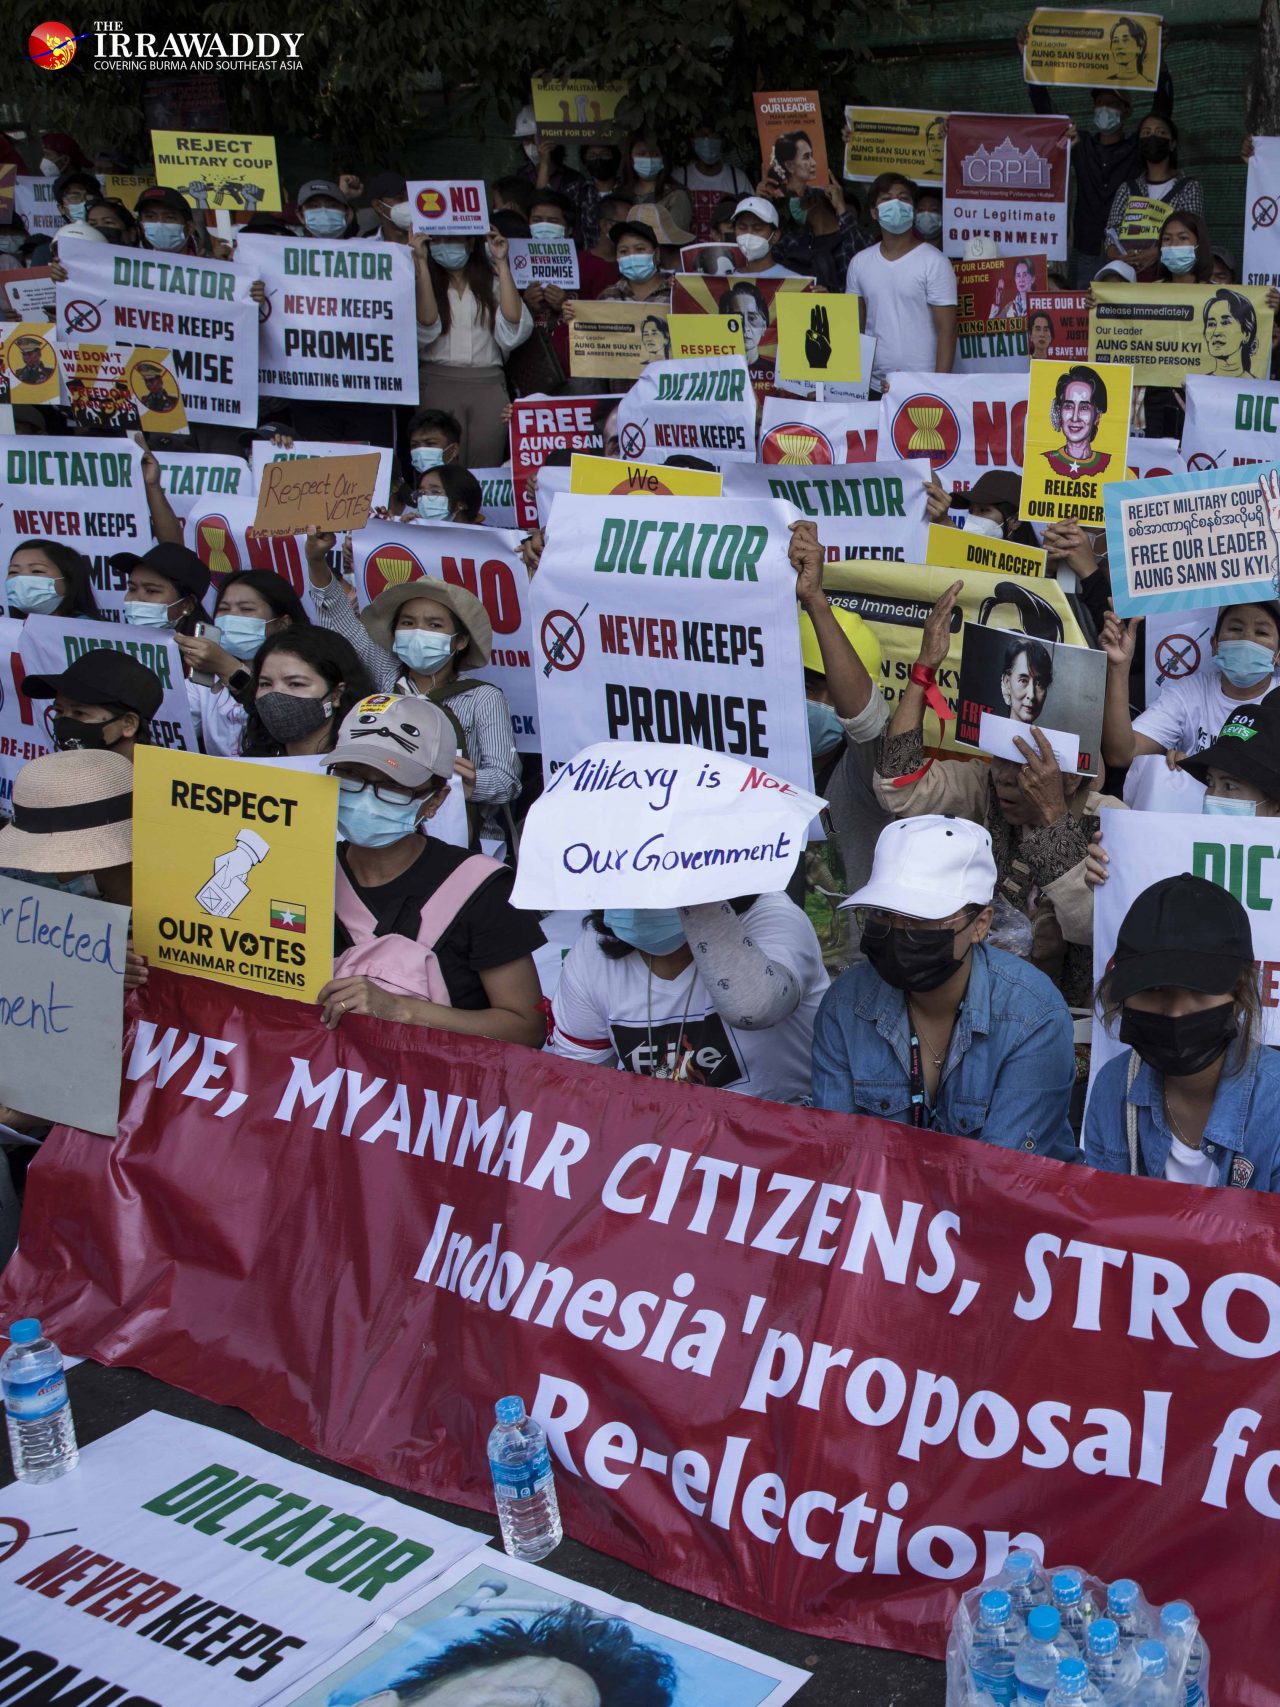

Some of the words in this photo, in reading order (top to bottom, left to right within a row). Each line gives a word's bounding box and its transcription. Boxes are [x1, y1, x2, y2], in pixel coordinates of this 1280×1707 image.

[177, 138, 252, 154] REJECT
[159, 154, 227, 168] MILITARY
[233, 157, 273, 169] COUP
[968, 157, 1044, 185] CRPH
[449, 187, 480, 213] NO
[954, 207, 977, 219] Our
[984, 207, 1056, 223] Legitimate
[528, 243, 571, 255] DICTATOR
[530, 256, 551, 264] NEVER
[552, 257, 573, 265] KEEPS
[114, 256, 236, 301] DICTATOR
[284, 248, 393, 281] DICTATOR
[531, 265, 574, 278] PROMISE
[1248, 273, 1269, 287] STOP
[284, 295, 338, 317] NEVER
[341, 299, 393, 321] KEEPS
[1100, 306, 1131, 316] Release
[1132, 306, 1190, 319] Immediately
[115, 306, 174, 333] NEVER
[178, 312, 234, 342] KEEPS
[1096, 326, 1112, 336] Our
[1113, 326, 1143, 336] Leader
[284, 329, 394, 363] PROMISE
[1096, 340, 1128, 351] AUNG
[1130, 341, 1153, 352] SAN
[1155, 341, 1179, 352] SUU
[1181, 342, 1201, 353] KYI
[1113, 355, 1157, 365] ARRESTED
[1159, 356, 1201, 366] PERSONS
[278, 369, 339, 388] NEGOTIATING
[342, 374, 371, 390] WITH
[374, 376, 402, 392] THEM
[519, 407, 595, 433] FREE
[520, 435, 566, 450] AUNG
[573, 434, 603, 449] SAN
[654, 423, 699, 449] NEVER
[700, 425, 745, 450] KEEPS
[7, 450, 132, 488] DICTATOR
[264, 466, 331, 507] Respect
[334, 472, 360, 497] Our
[1044, 479, 1098, 499] RELEASE
[325, 495, 371, 522] VOTES
[1028, 500, 1057, 517] OUR
[1058, 501, 1104, 522] LEADER
[1129, 498, 1171, 520] REJECT
[1173, 492, 1228, 516] MILITARY
[1231, 488, 1263, 506] COUP
[13, 510, 80, 537] NEVER
[85, 512, 138, 538] KEEPS
[594, 518, 769, 582] DICTATOR
[1131, 544, 1169, 567] FREE
[1172, 540, 1206, 561] OUR
[1208, 531, 1268, 558] LEADER
[1134, 569, 1174, 590] AUNG
[1177, 564, 1217, 585] SANN
[1220, 561, 1241, 579] SU
[1244, 555, 1270, 577] KYI
[599, 614, 678, 660] NEVER
[682, 620, 764, 667] KEEPS
[605, 683, 770, 759] PROMISE
[1232, 713, 1254, 728] 501
[547, 758, 678, 811] Military
[696, 763, 721, 788] is
[740, 767, 800, 797] Not
[171, 779, 298, 827] RESPECT
[563, 841, 629, 875] Our
[632, 832, 791, 872] Government
[16, 895, 125, 975] Elected
[158, 916, 212, 949] OUR
[220, 930, 306, 967] VOTES
[158, 945, 235, 976] MYANMAR
[238, 960, 306, 988] CITIZENS
[625, 1040, 727, 1082] Fire
[125, 1020, 248, 1118] WE,
[273, 1057, 591, 1201] MYANMAR
[602, 1142, 980, 1316] CITIZENS,
[525, 1372, 1046, 1582] Re-election
[141, 1463, 435, 1602] DICTATOR
[15, 1544, 182, 1628] NEVER
[137, 1593, 307, 1682] KEEPS
